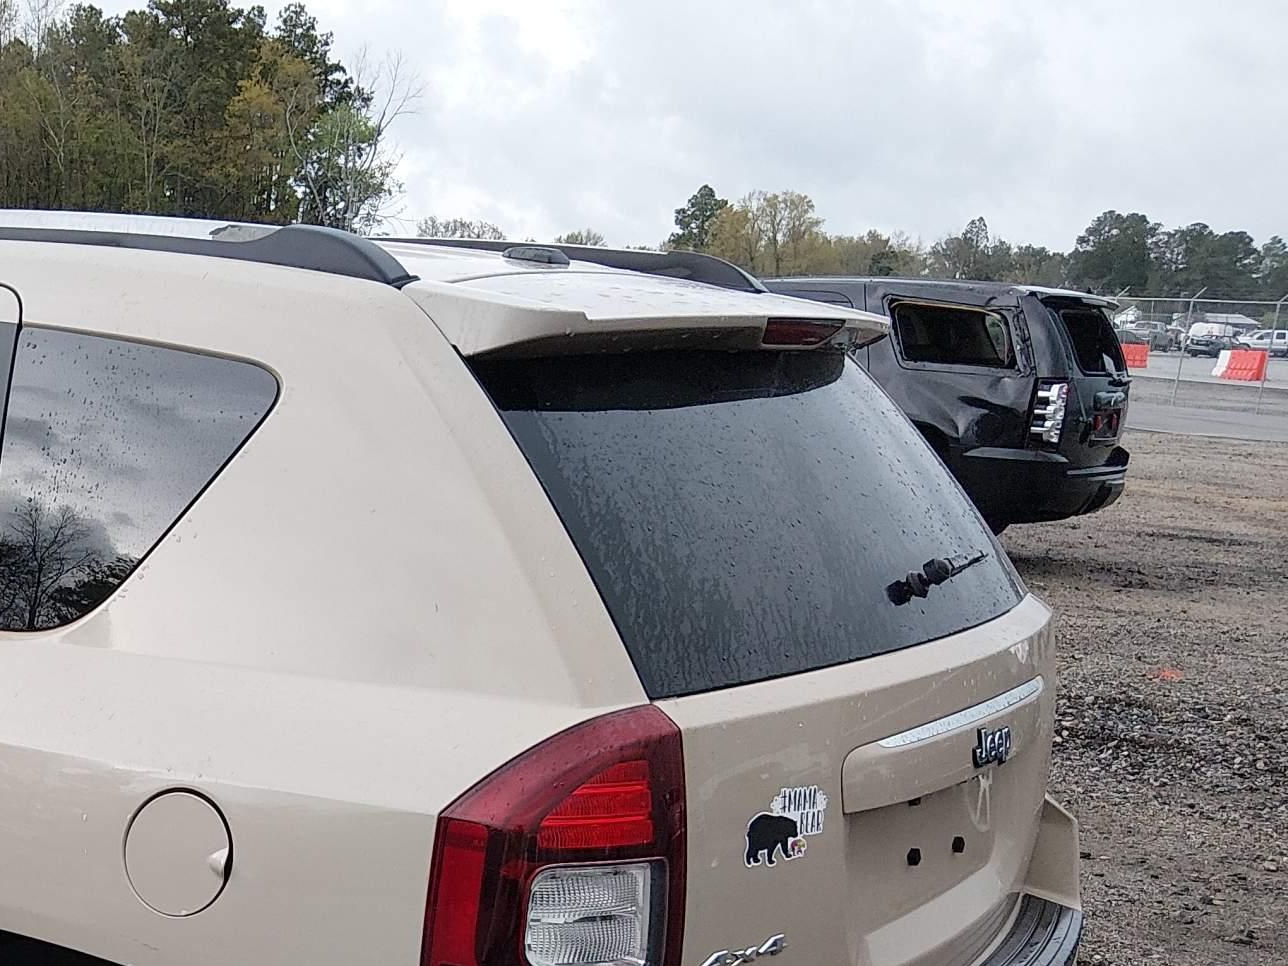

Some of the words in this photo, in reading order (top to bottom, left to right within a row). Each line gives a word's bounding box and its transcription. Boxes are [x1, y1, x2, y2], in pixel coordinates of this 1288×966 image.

[972, 726, 1011, 768] Jeep
[779, 786, 818, 813] #MAMA
[799, 810, 823, 834] BEAR
